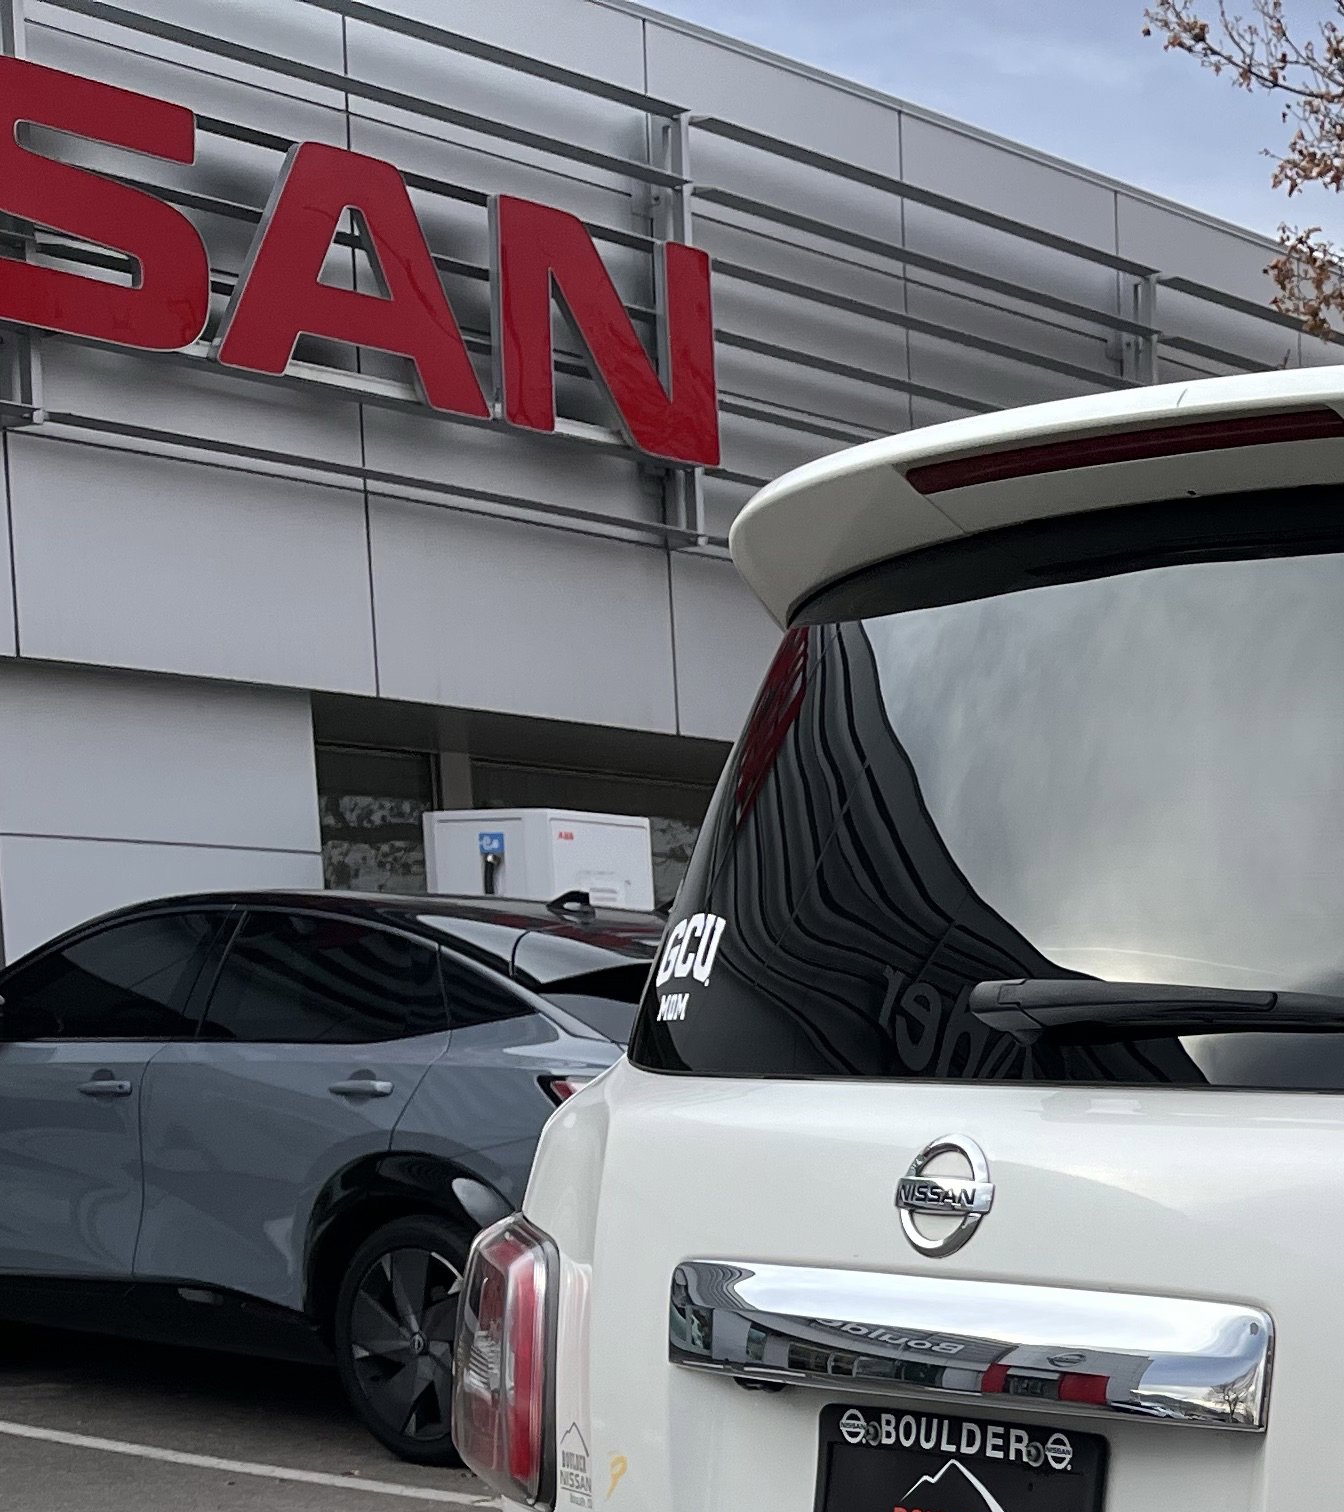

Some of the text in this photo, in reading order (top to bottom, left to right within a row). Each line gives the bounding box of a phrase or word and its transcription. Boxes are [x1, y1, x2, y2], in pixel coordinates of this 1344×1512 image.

[655, 913, 727, 987] GCU
[656, 993, 690, 1021] MOM
[899, 1184, 977, 1206] NISSAN
[880, 1413, 1030, 1463] BOULDER
